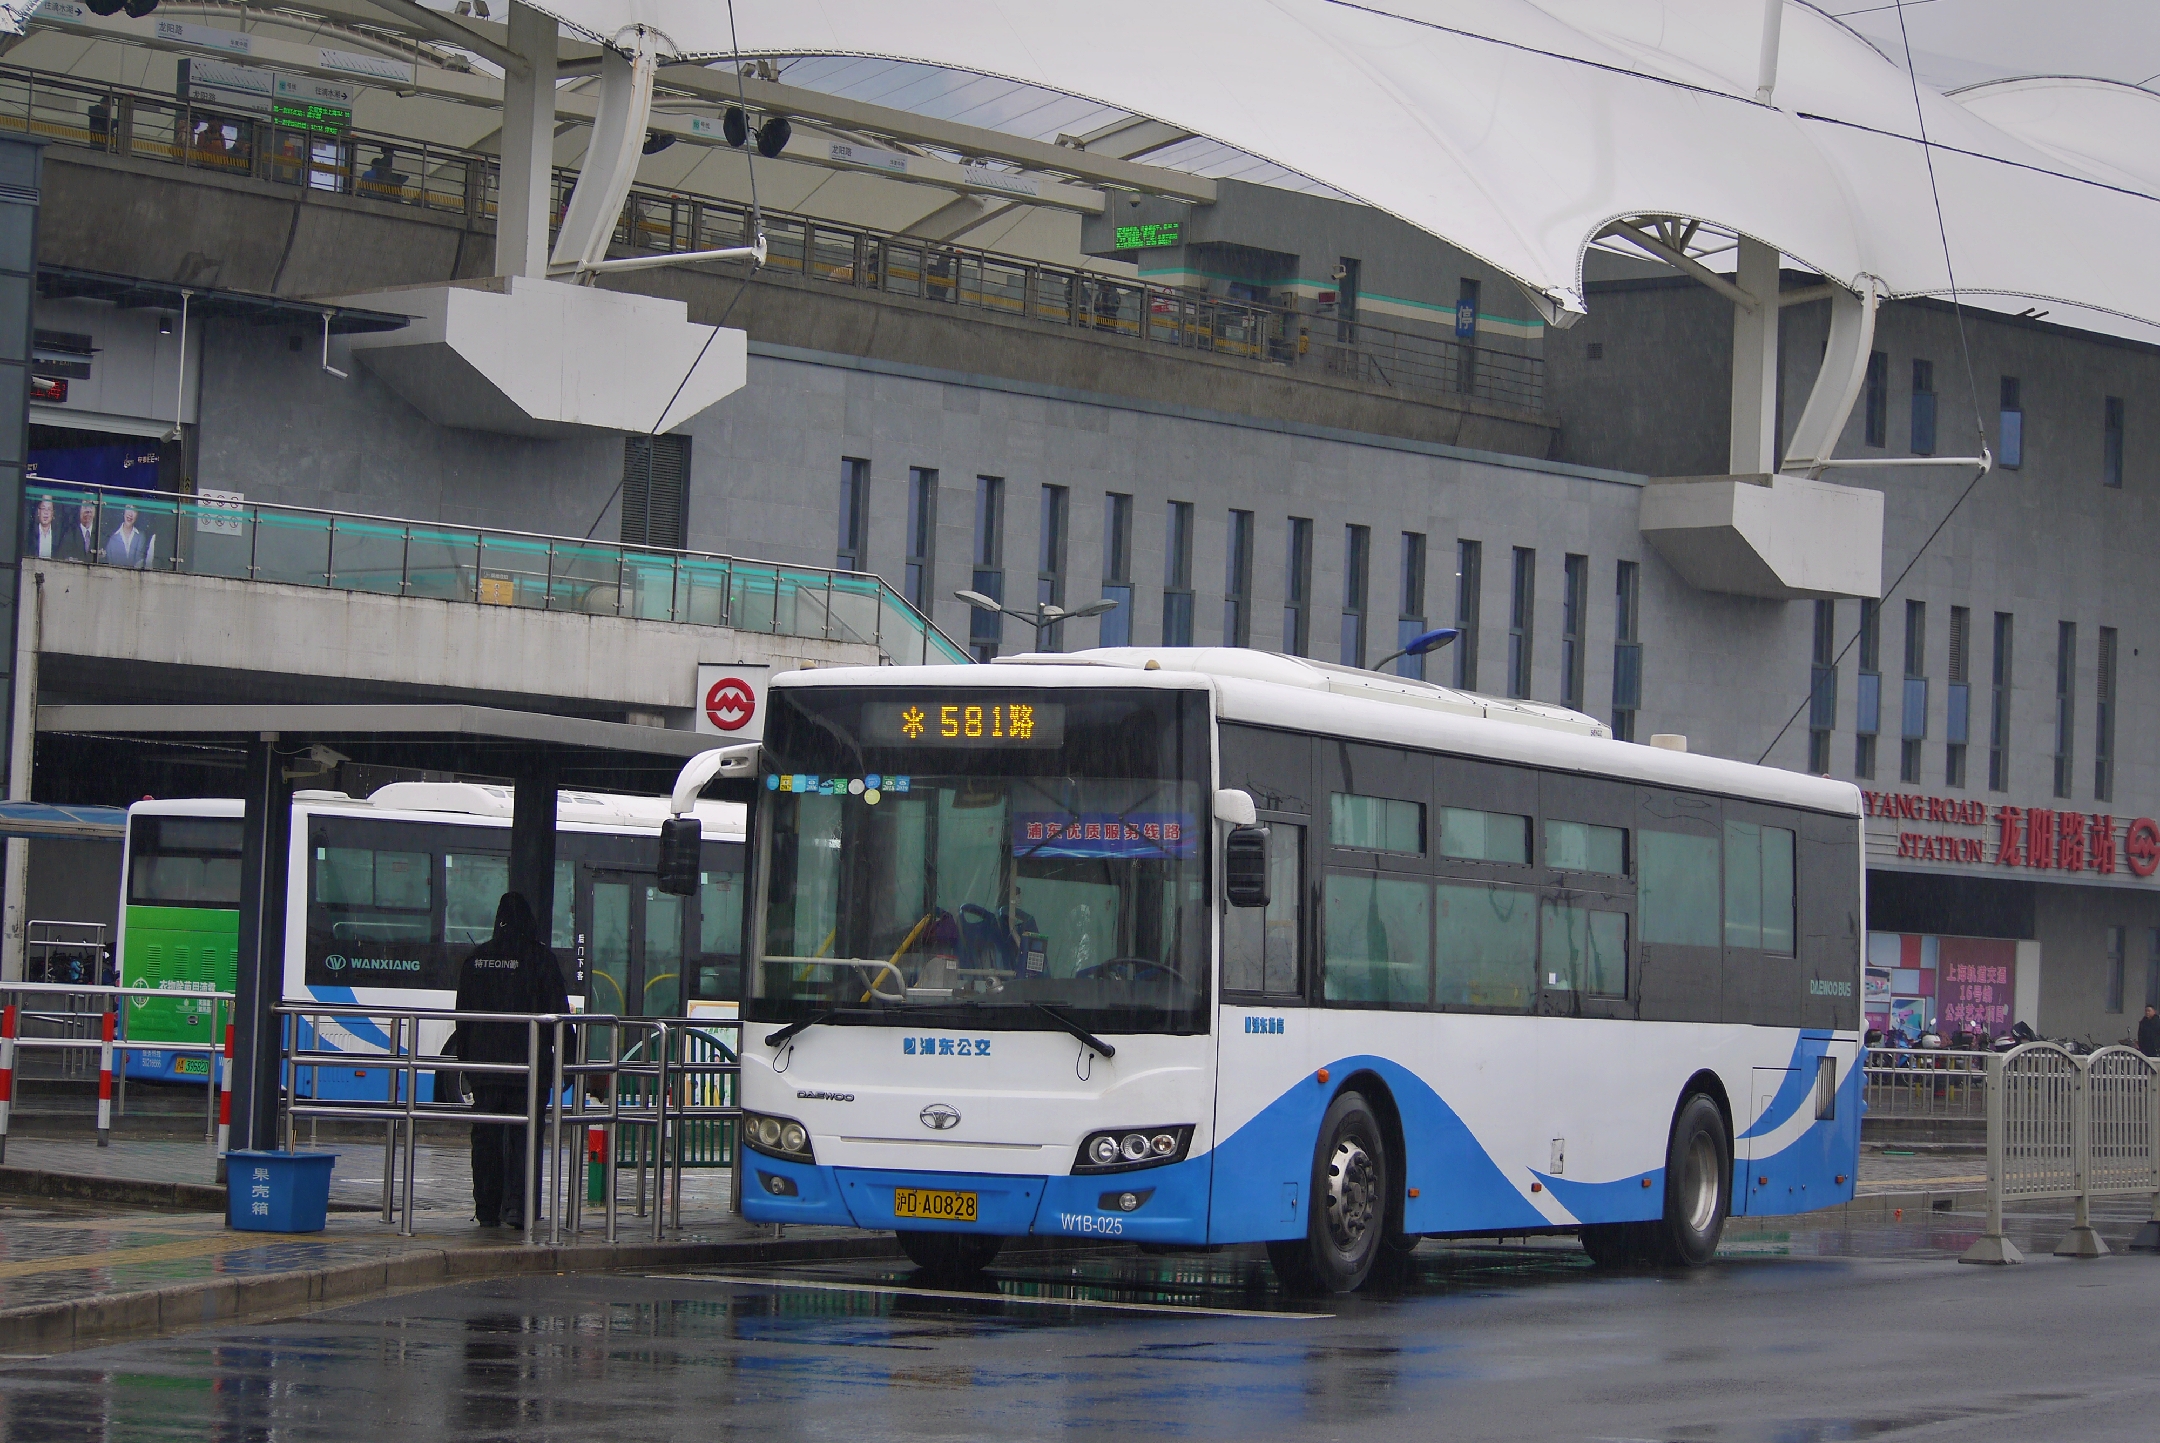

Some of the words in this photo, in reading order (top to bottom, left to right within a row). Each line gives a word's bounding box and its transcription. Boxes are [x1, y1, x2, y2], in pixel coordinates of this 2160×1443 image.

[158, 21, 183, 35] 龙阳路
[831, 144, 852, 157] 龙阳路
[1458, 305, 1473, 330] 停
[941, 704, 1035, 740] 581路
[1862, 790, 1925, 820] YANG
[1928, 796, 1987, 825] ROAD
[1027, 822, 1181, 840] 浦东优质服务线路
[1994, 805, 2117, 875] 龙阳路站
[1898, 831, 1985, 863] STATION
[350, 957, 421, 971] WANXIANG
[576, 933, 585, 981] 后门下客
[1946, 962, 2007, 984] 上海轨道交通
[1810, 979, 1838, 996] DAEWOO
[1838, 981, 1851, 997] BUS
[1959, 984, 1993, 1004] 16号线
[920, 1037, 991, 1056] 浦东公交
[797, 1090, 855, 1102] DAEWOO
[251, 1167, 270, 1216] 果壳箱
[1061, 1212, 1123, 1236] W1B-025
